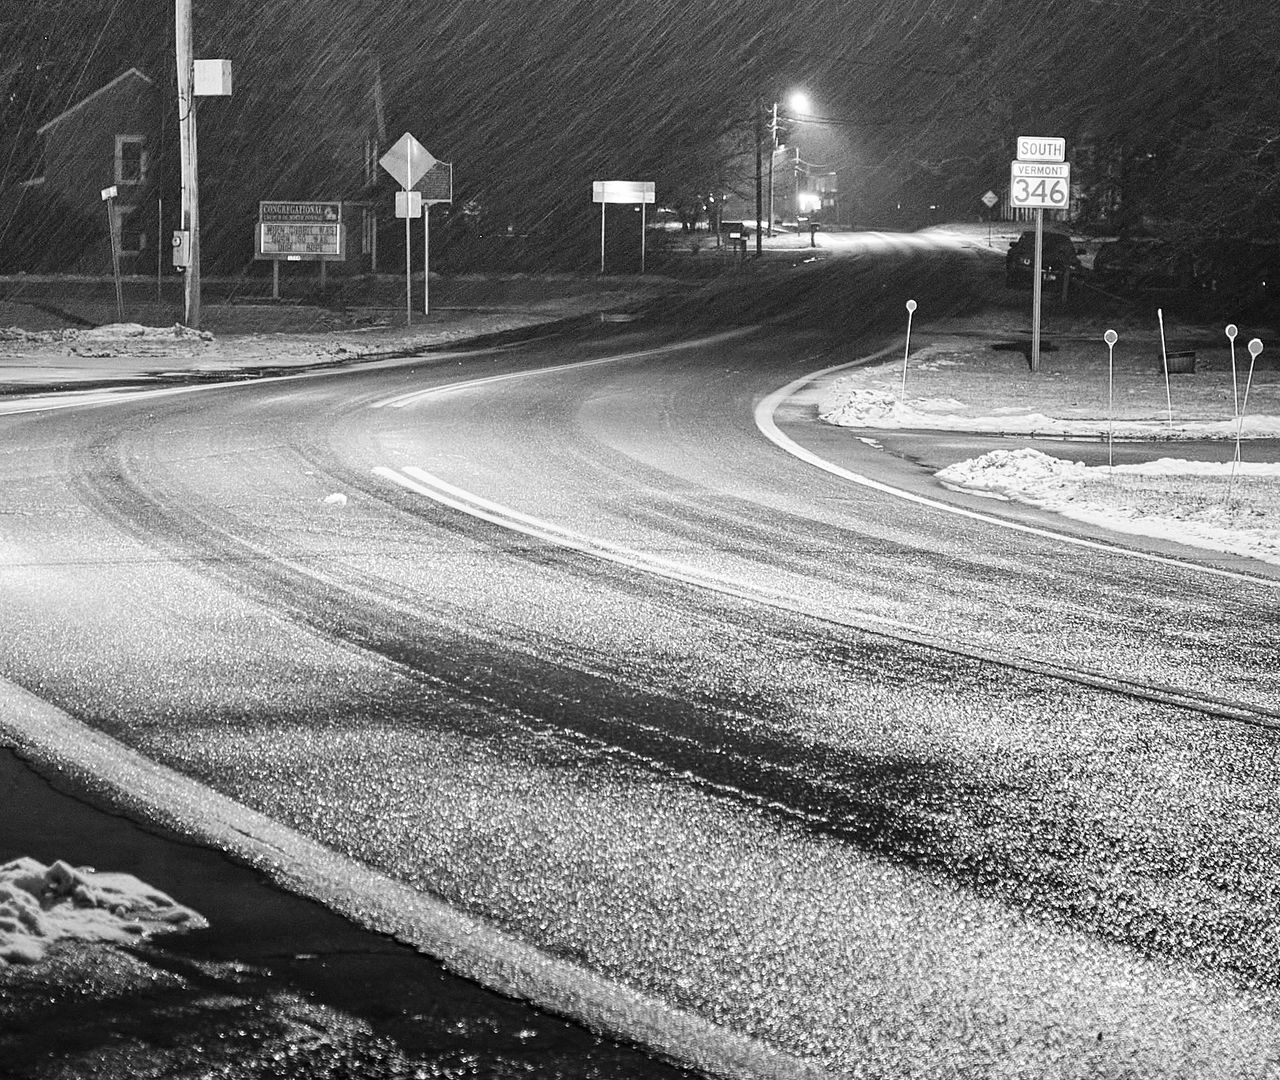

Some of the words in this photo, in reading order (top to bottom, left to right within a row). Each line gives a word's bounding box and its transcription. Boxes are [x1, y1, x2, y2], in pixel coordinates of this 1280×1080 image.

[1021, 141, 1061, 156] SOUTH
[1018, 166, 1064, 175] VERMONT
[1015, 179, 1065, 204] 346
[263, 205, 322, 214] CONGREGATIONAL
